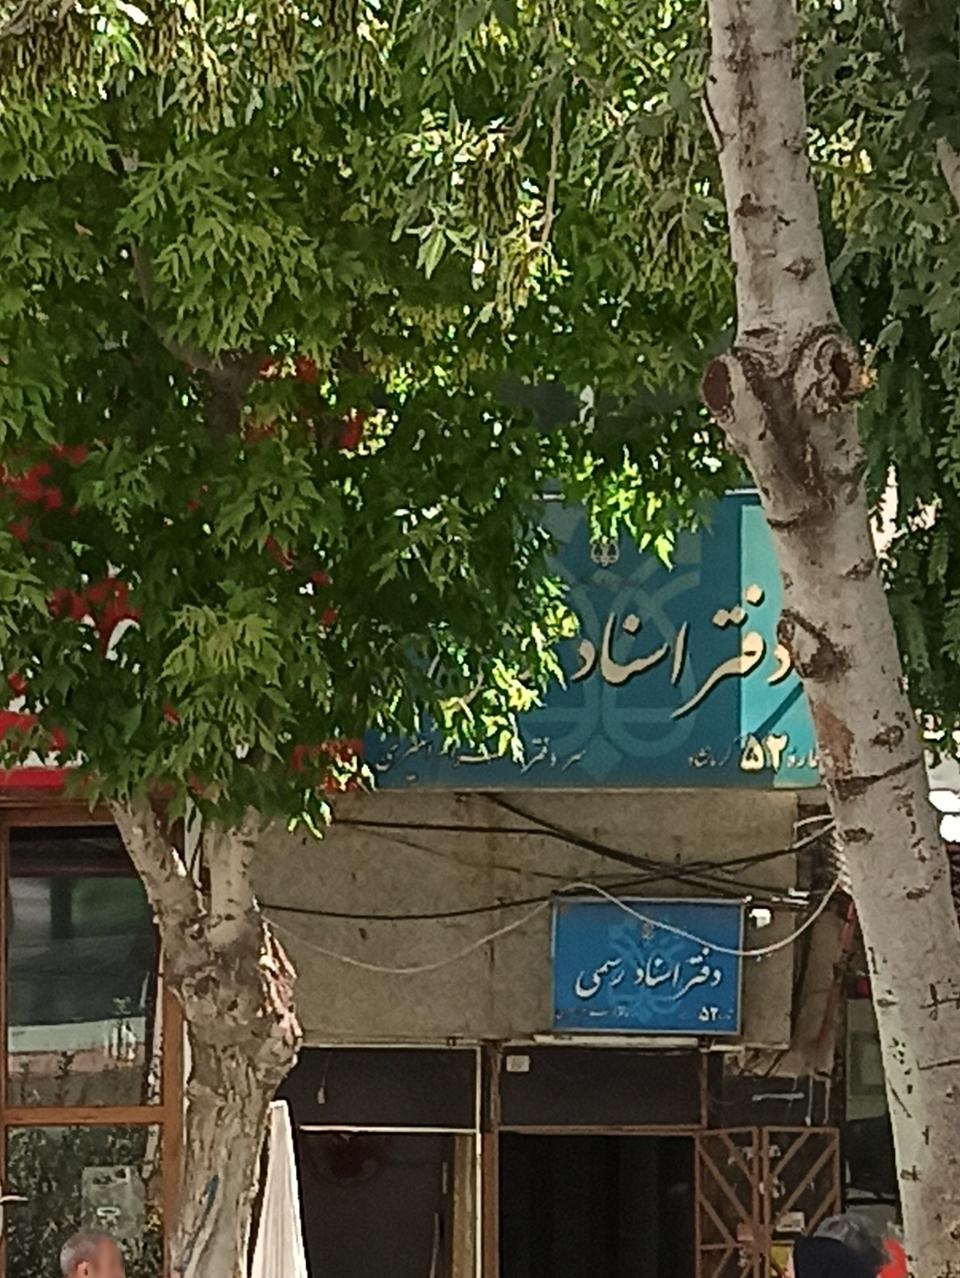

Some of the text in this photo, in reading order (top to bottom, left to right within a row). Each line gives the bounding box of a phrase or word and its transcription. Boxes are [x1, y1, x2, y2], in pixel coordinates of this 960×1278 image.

[570, 612, 687, 684] اسناد
[671, 584, 791, 719] دفتر
[740, 733, 788, 771] ۵۲
[574, 947, 722, 1001] دفتر اسناد رسمی
